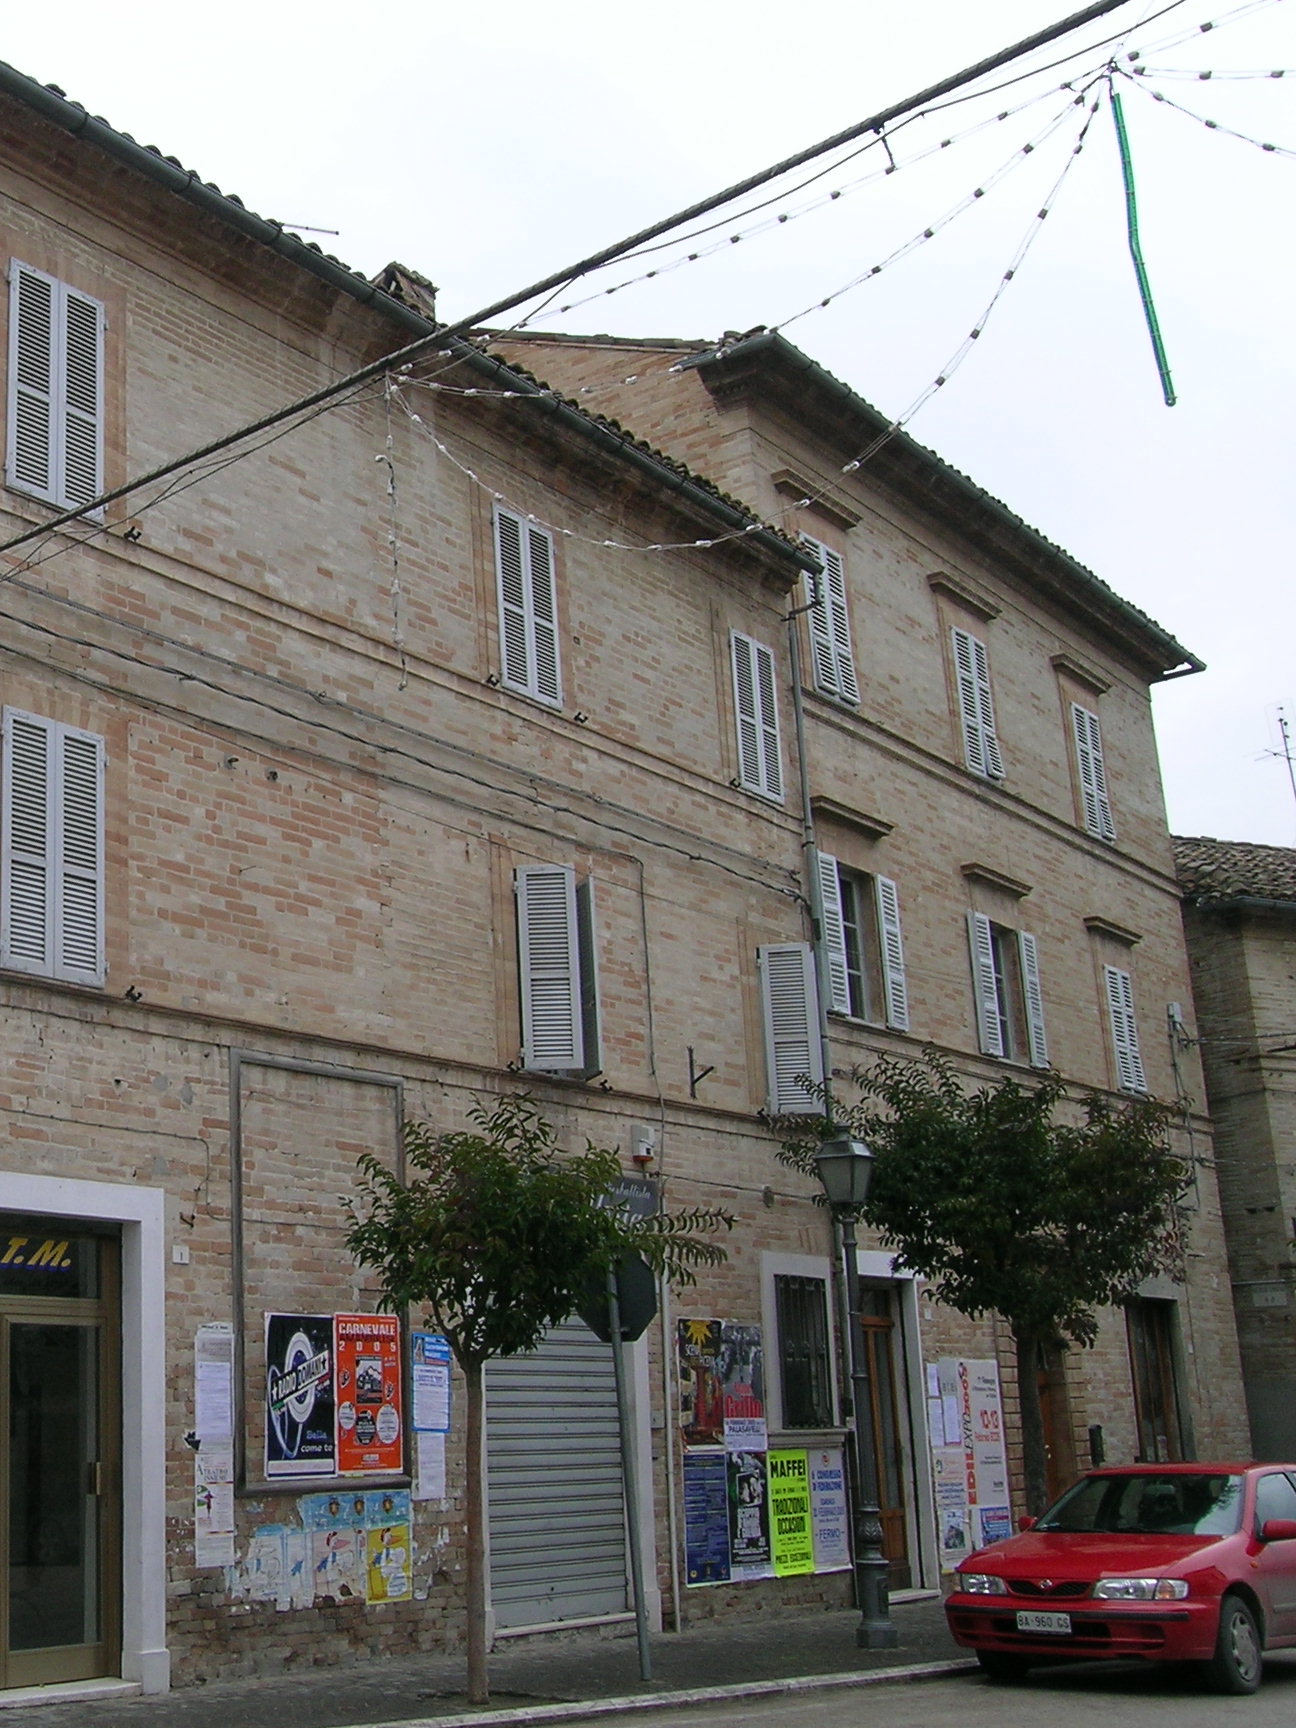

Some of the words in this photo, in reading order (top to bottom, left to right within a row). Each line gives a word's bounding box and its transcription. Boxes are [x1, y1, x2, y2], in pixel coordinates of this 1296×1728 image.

[338, 1323, 396, 1336] CARNEVALE
[300, 1444, 322, 1453] come
[323, 1443, 333, 1452] te
[770, 1459, 806, 1478] MAFFEI
